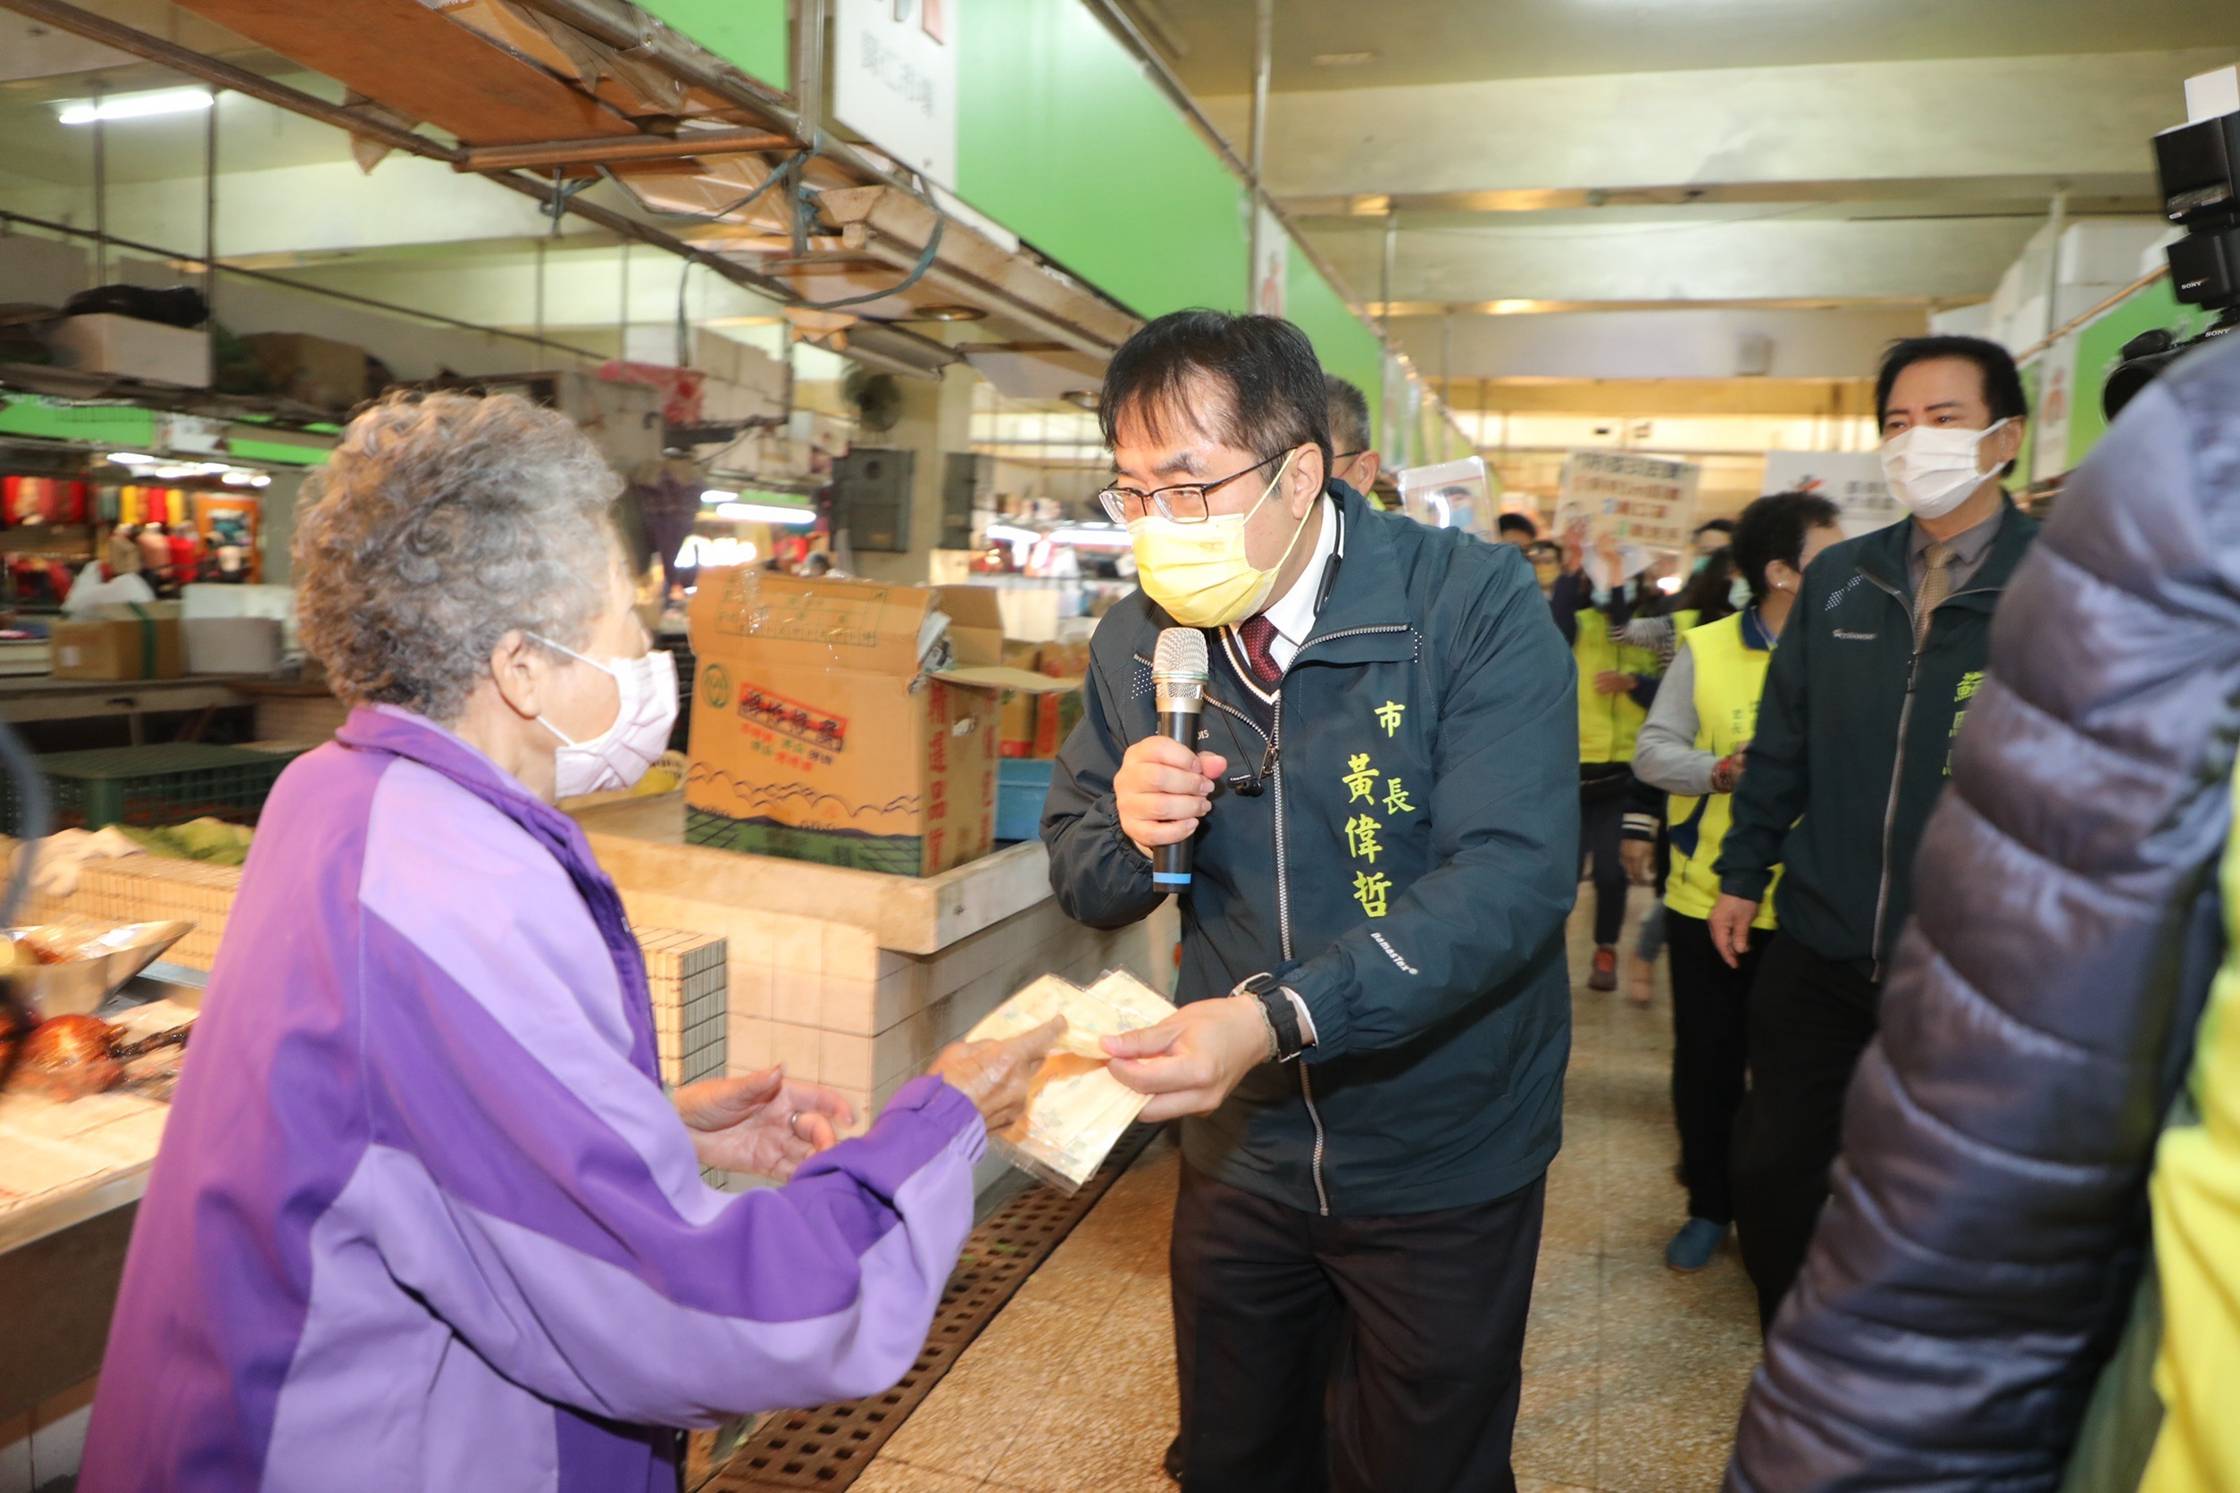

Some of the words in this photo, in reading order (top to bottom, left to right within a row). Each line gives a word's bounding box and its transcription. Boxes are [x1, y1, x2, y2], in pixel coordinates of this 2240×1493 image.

[2181, 280, 2202, 290] SONY
[2204, 327, 2231, 338] SONY
[1342, 752, 1393, 918] 黃偉哲
